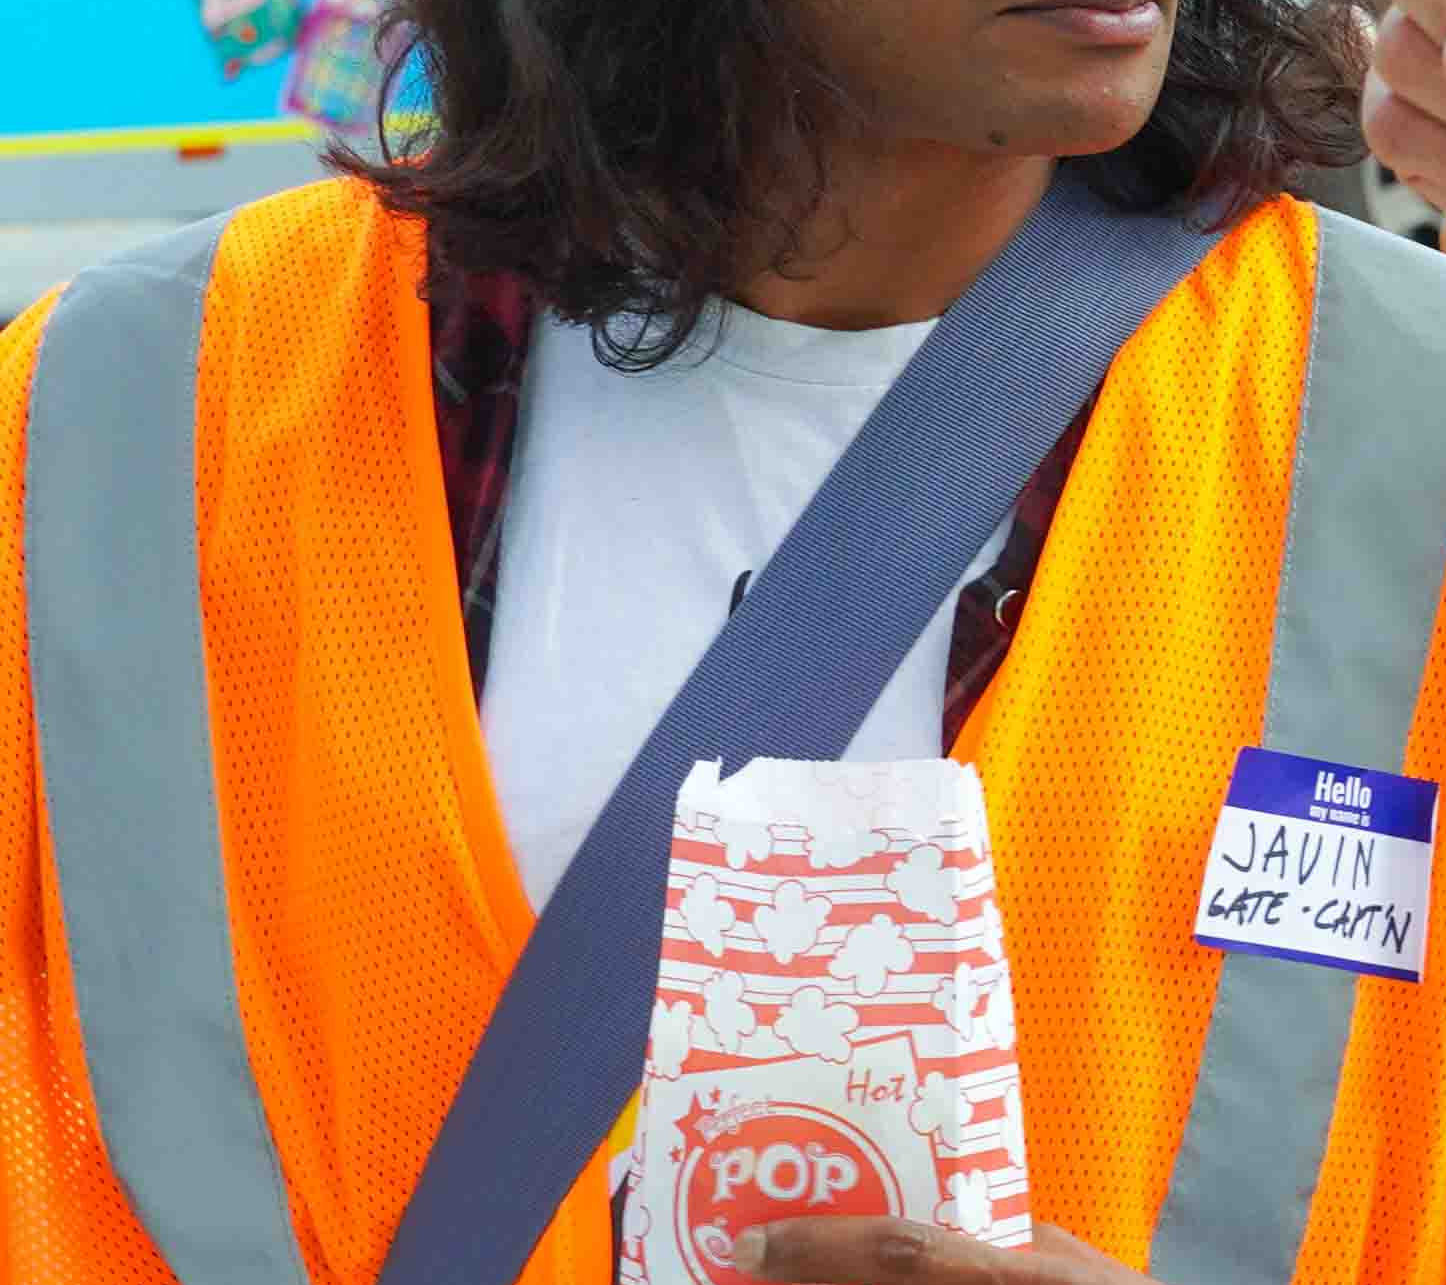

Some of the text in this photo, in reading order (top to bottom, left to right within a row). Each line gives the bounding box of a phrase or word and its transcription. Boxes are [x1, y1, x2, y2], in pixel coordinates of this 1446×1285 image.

[1314, 769, 1372, 809] Hello
[846, 1068, 905, 1106] Hot
[709, 1141, 859, 1208] POP
